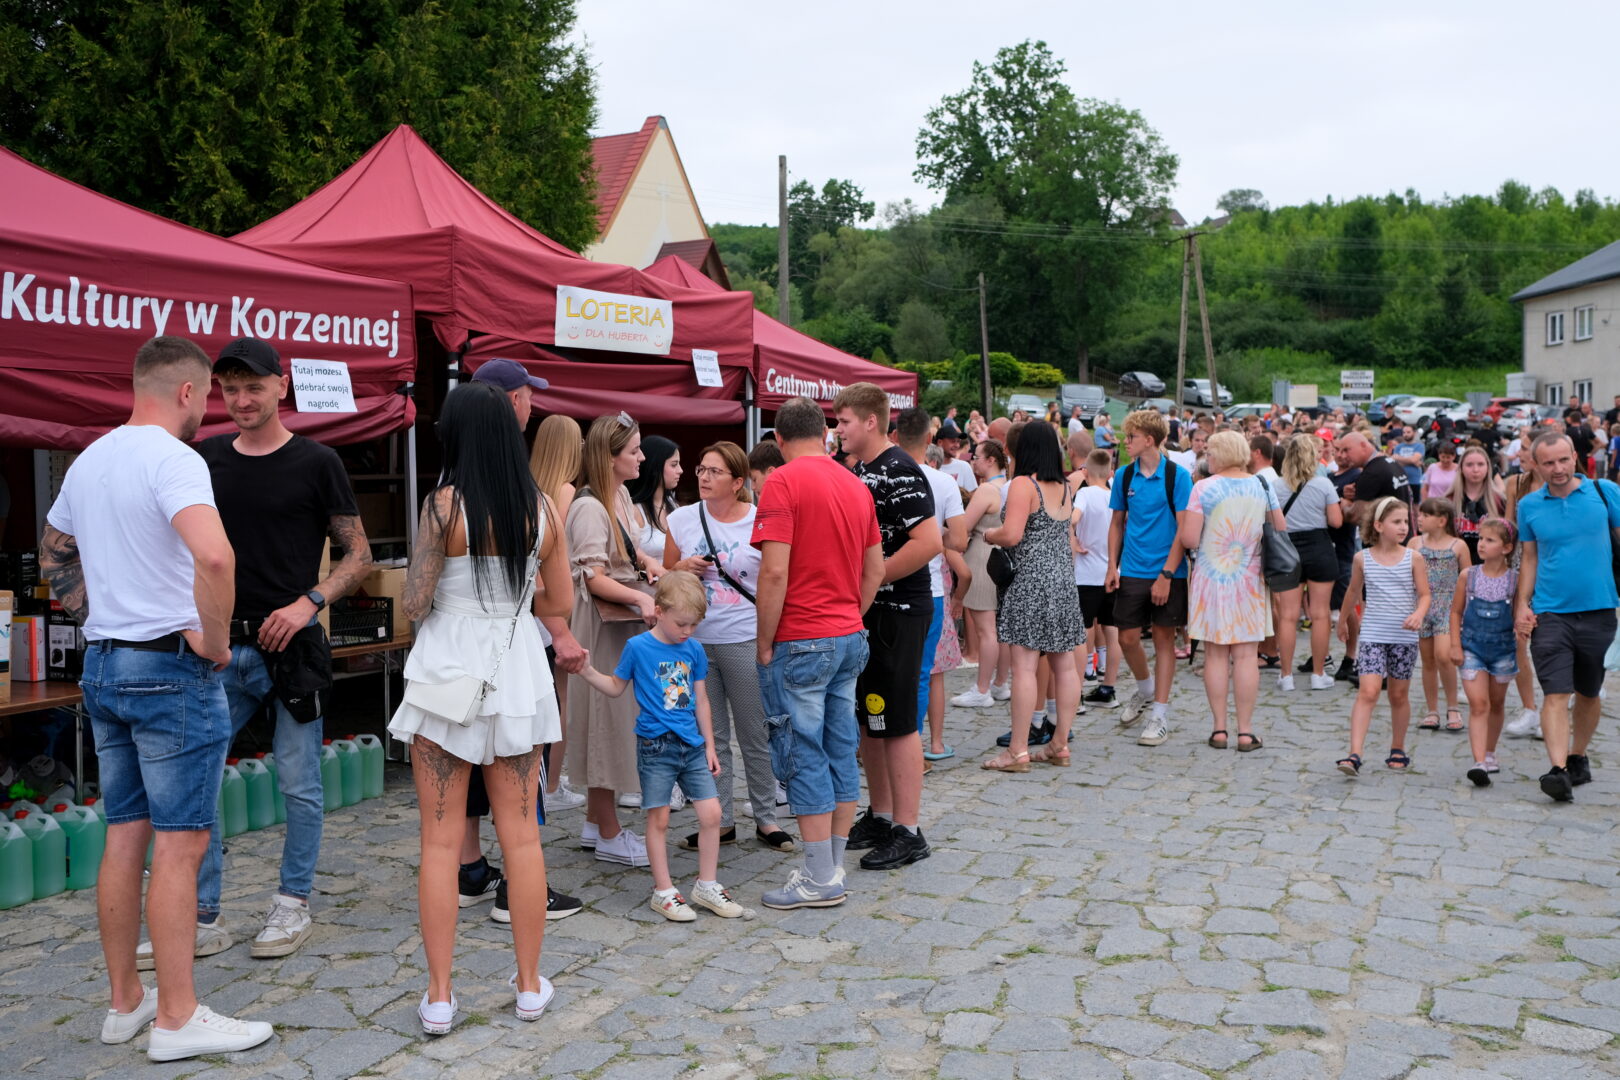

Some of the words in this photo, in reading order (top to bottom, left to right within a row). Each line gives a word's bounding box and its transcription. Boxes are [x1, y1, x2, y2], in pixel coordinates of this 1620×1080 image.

[2, 271, 173, 338] Kultury
[185, 301, 218, 335] w
[230, 296, 399, 358] Korzennej
[566, 296, 665, 328] LOTERIA
[585, 328, 604, 338] DLA
[608, 331, 648, 342] HUBERTA
[294, 365, 313, 376] Tutaj
[315, 367, 342, 376] możesz
[295, 383, 326, 392] odebrać
[327, 384, 349, 394] swoją
[765, 367, 819, 399] Centrum
[308, 400, 339, 409] nagrodę
